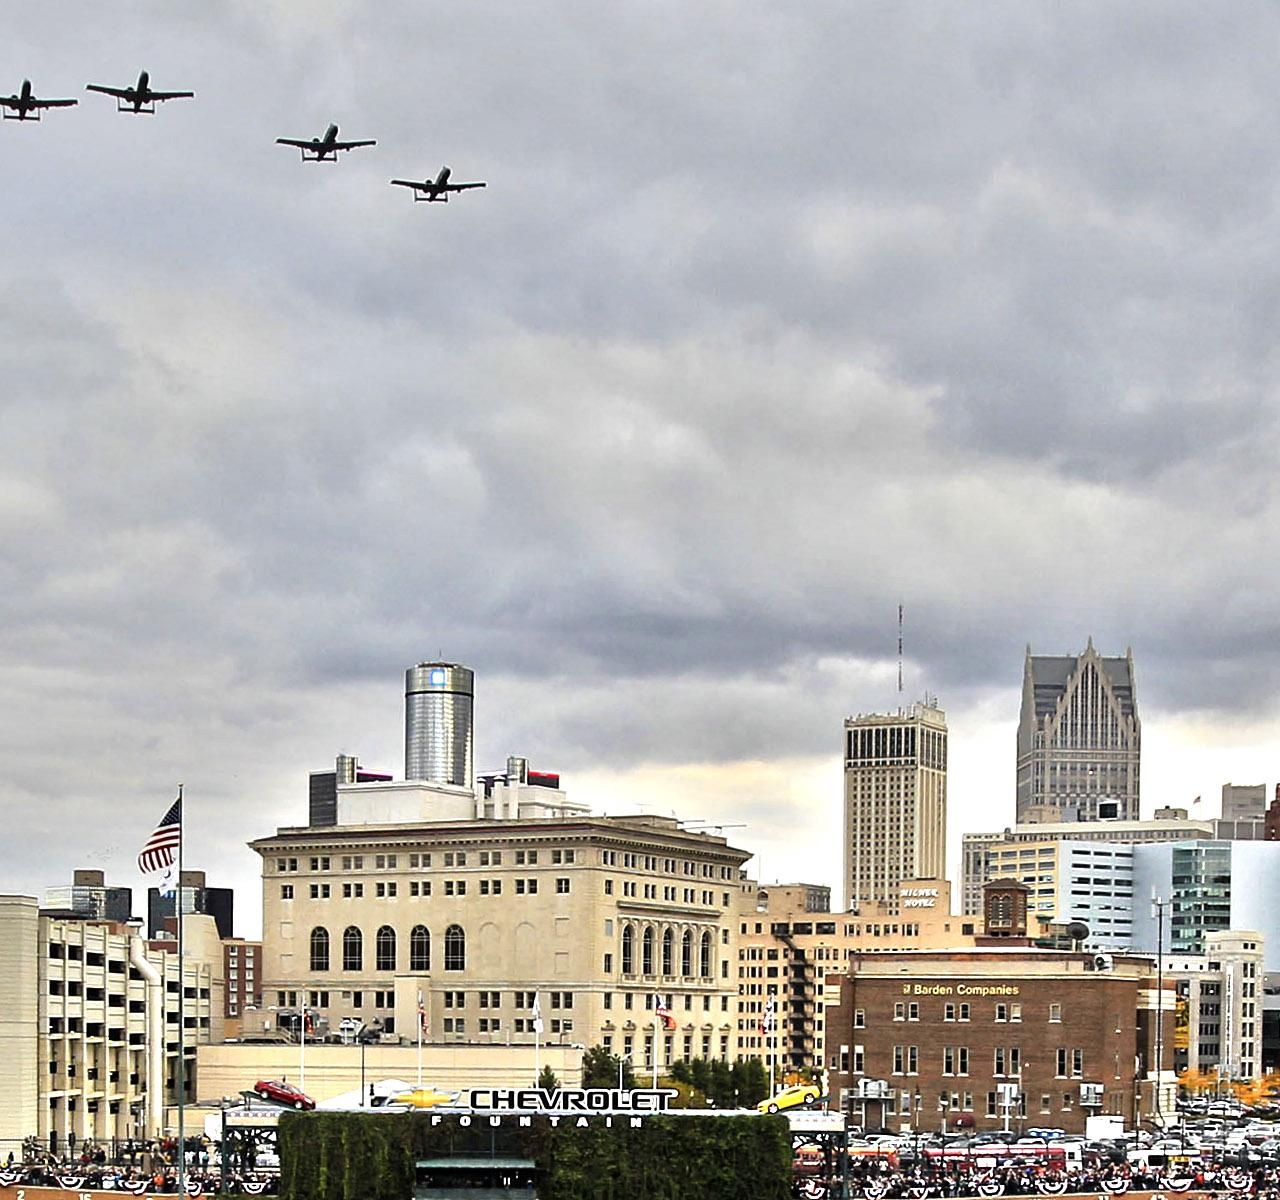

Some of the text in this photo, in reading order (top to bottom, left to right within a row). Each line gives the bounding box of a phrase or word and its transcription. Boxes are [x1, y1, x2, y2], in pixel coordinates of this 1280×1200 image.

[914, 984, 1020, 997] Barden Companies
[469, 1088, 679, 1112] CHEVROLET
[431, 1115, 642, 1128] FOUNTAIN
